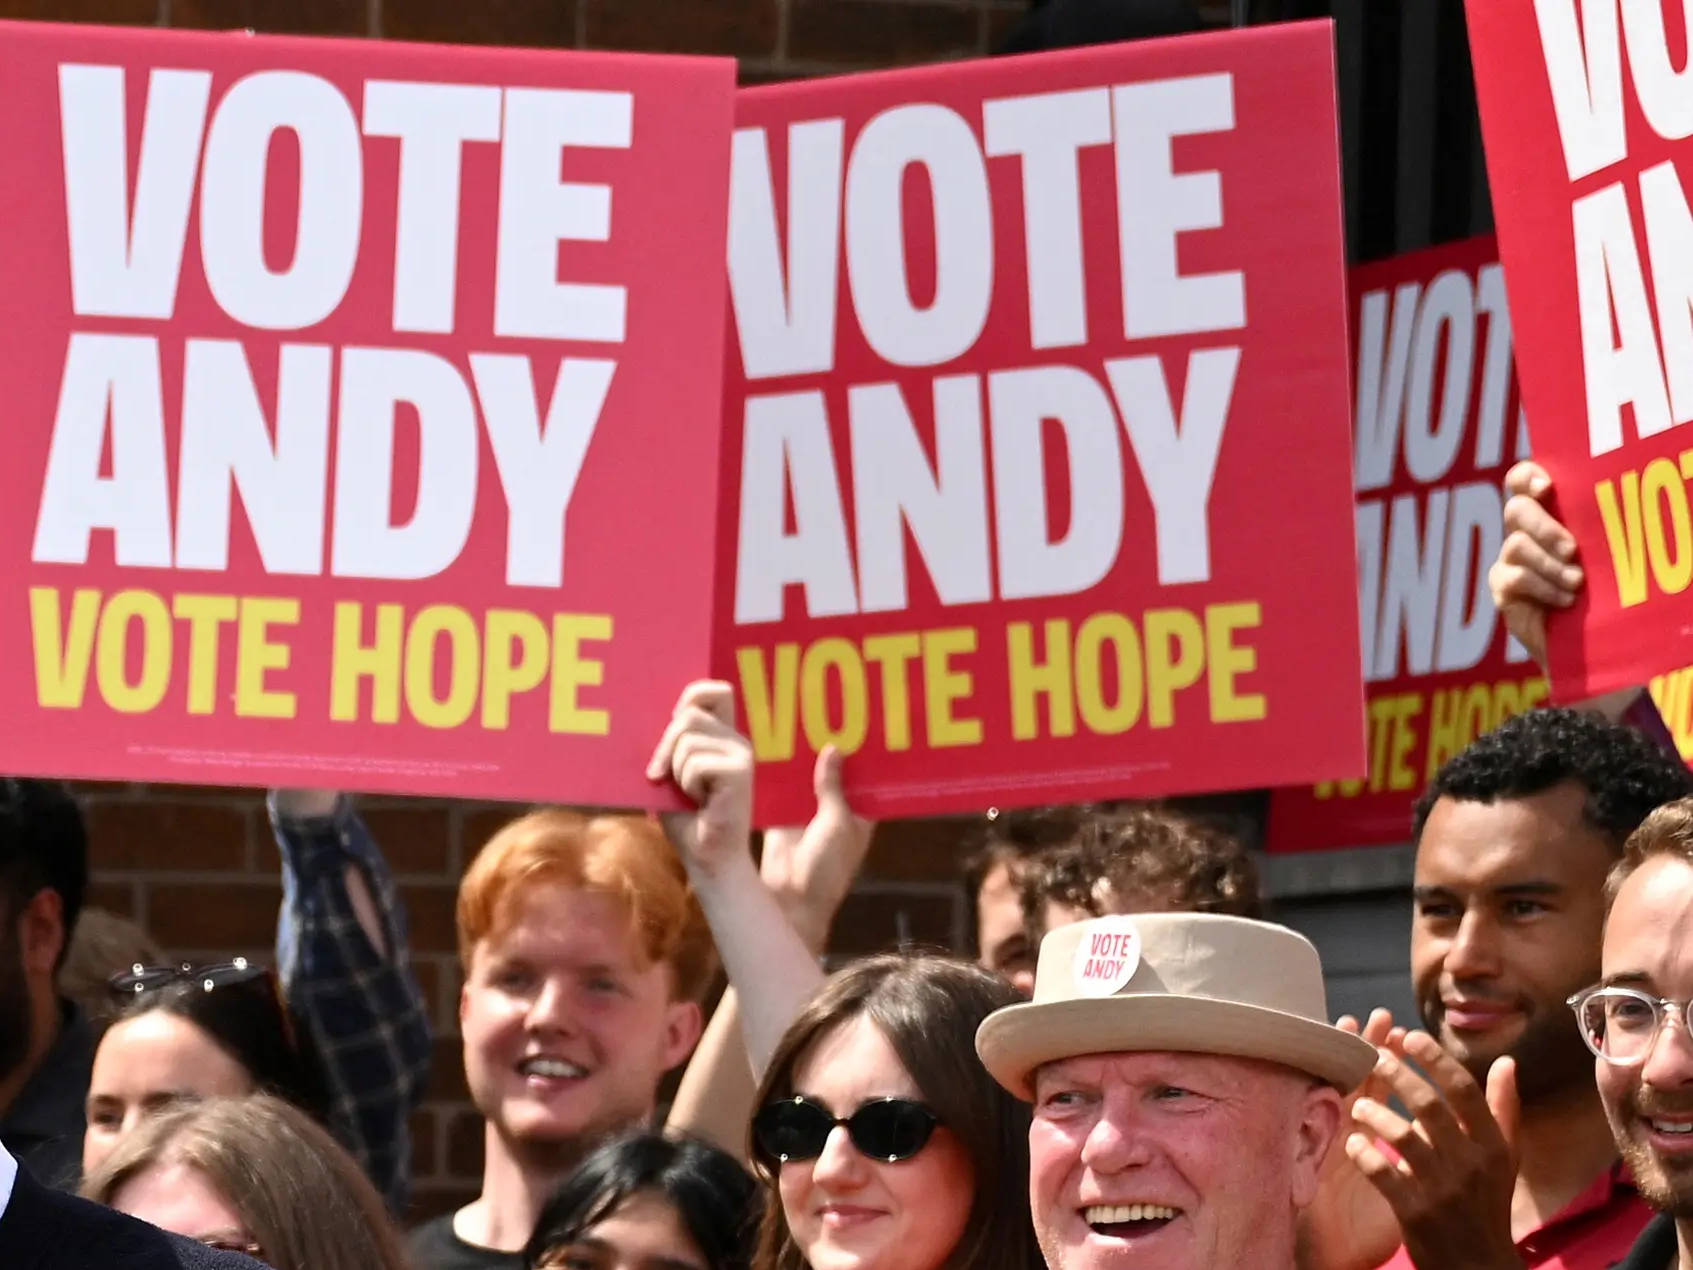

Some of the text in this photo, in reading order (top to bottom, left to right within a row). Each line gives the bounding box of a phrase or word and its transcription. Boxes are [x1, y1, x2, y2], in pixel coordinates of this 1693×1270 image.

[57, 63, 634, 343] VOTE
[726, 72, 1247, 380] VOTE
[30, 332, 618, 589] ANDY
[1354, 262, 1532, 492] VOT
[732, 347, 1242, 625] ANDY
[1594, 448, 1693, 609] VO
[29, 588, 614, 736] VOTE HOPE
[1356, 481, 1530, 682] ND
[736, 602, 1267, 763] VOTE HOPE
[1313, 693, 1422, 800] TE
[1082, 959, 1125, 981] ANDY
[1090, 933, 1132, 957] VOTE
